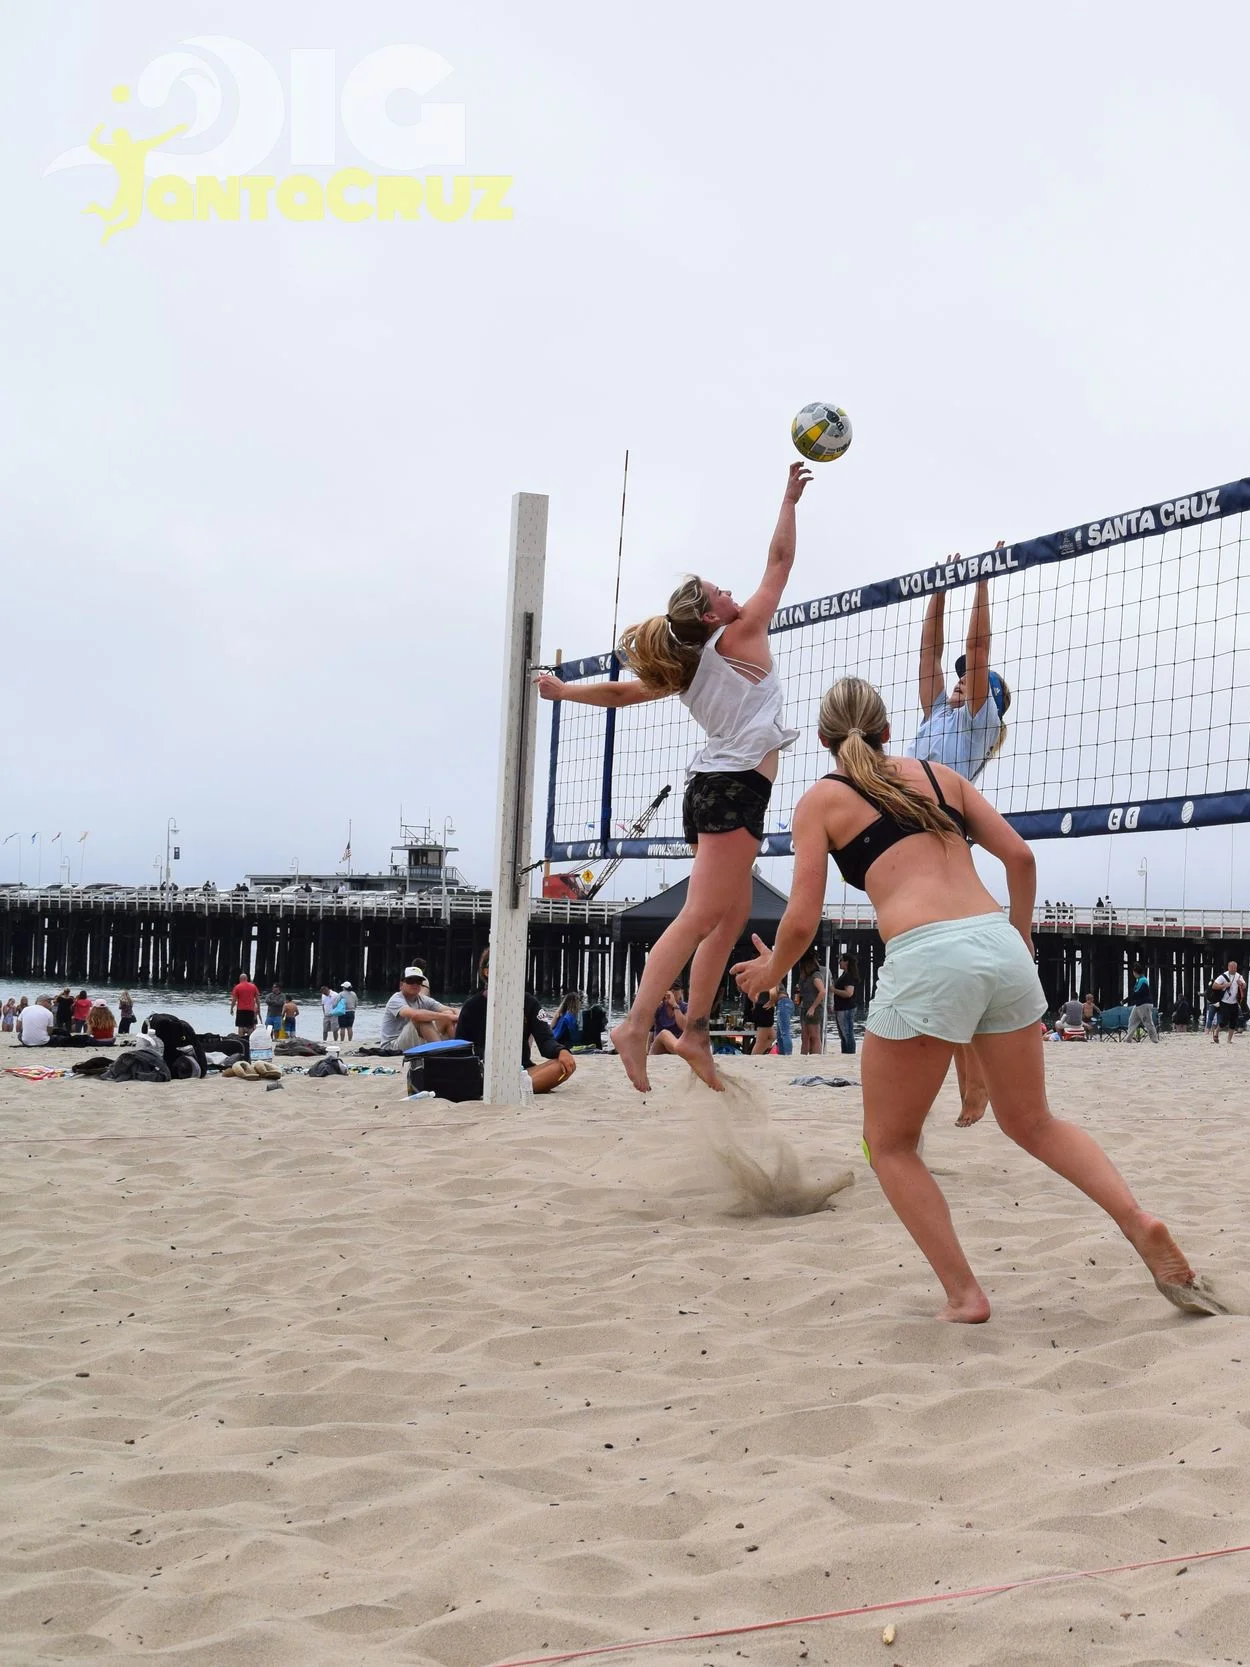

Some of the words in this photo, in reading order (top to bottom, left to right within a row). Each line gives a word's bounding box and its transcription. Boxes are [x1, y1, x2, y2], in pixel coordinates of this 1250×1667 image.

[1087, 509, 1156, 547] SANTA
[1159, 490, 1221, 527] CRUZ
[899, 548, 1018, 596] VOLLEYBALL
[769, 608, 805, 630] MAIN
[809, 590, 862, 619] BEACH
